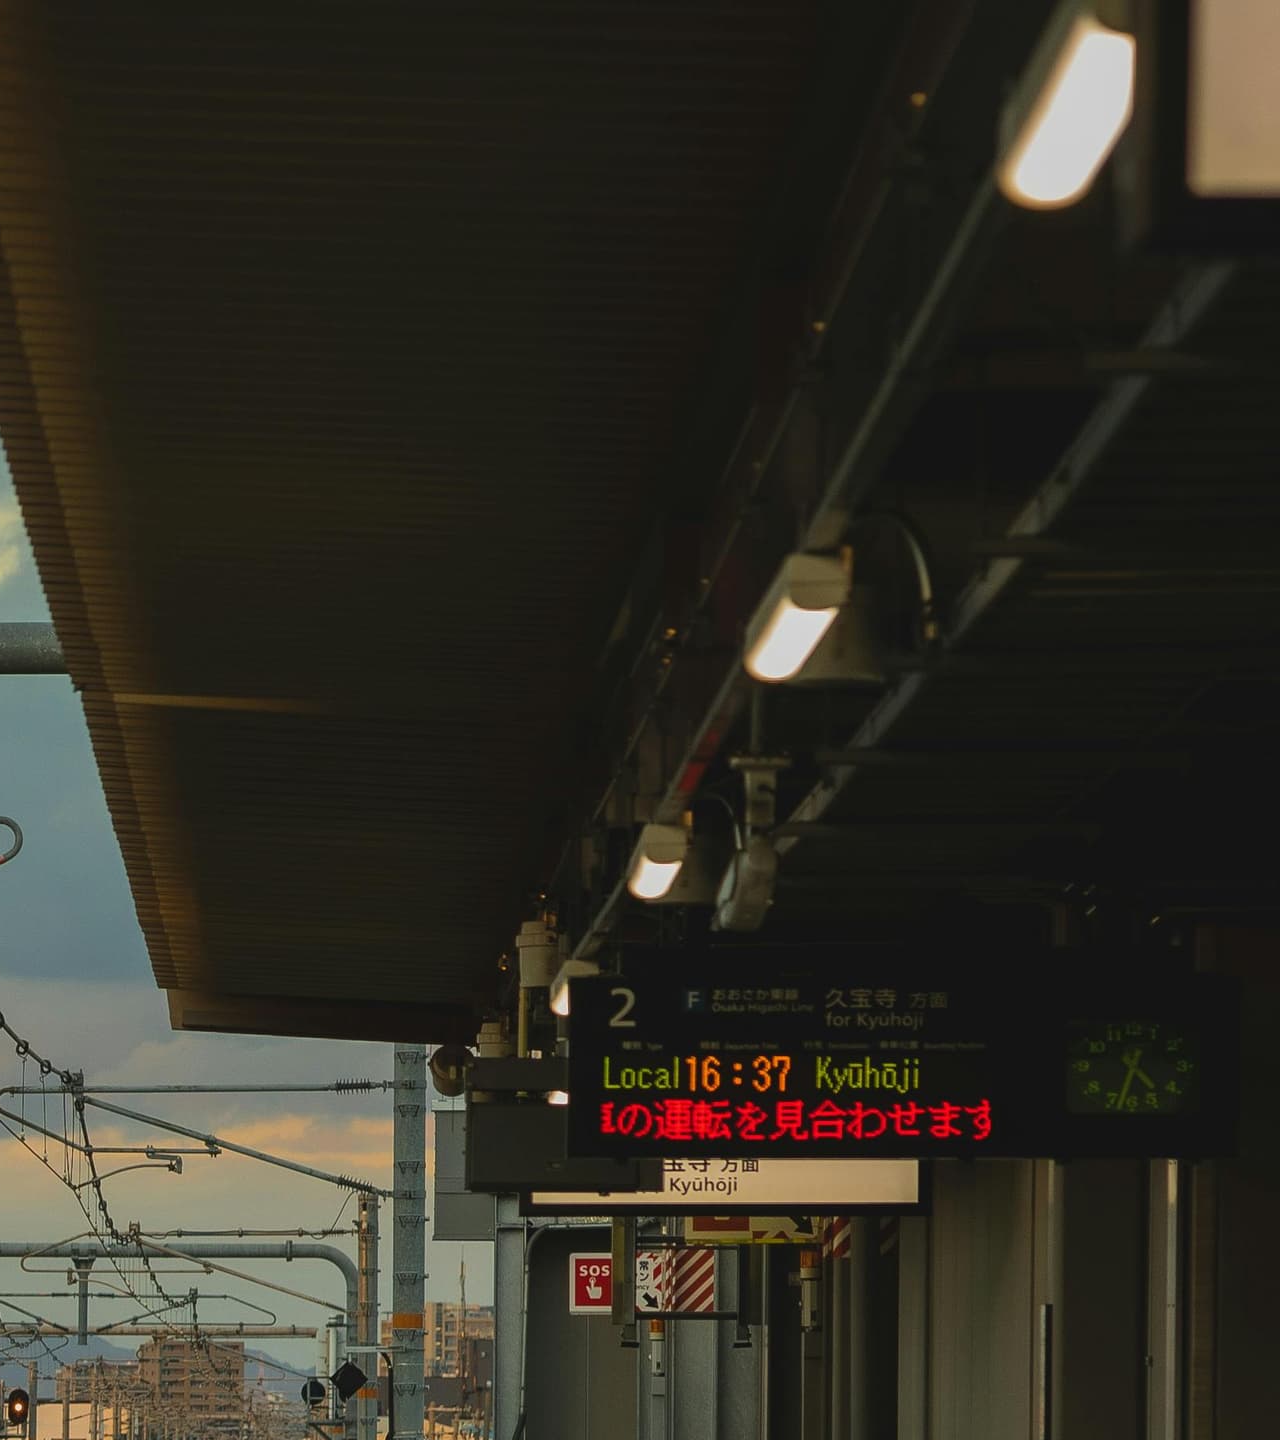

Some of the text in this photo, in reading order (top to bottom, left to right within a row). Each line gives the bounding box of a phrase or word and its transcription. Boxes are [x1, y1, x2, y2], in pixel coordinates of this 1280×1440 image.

[607, 986, 638, 1028] 2
[687, 990, 702, 1010] F
[825, 987, 948, 1009] 久宝寺 方面
[825, 1011, 852, 1028] for
[603, 1055, 680, 1090] Local
[815, 1055, 920, 1095] Kyūhōji
[669, 1176, 738, 1196] Kyūhōji
[578, 1264, 610, 1277] SOS
